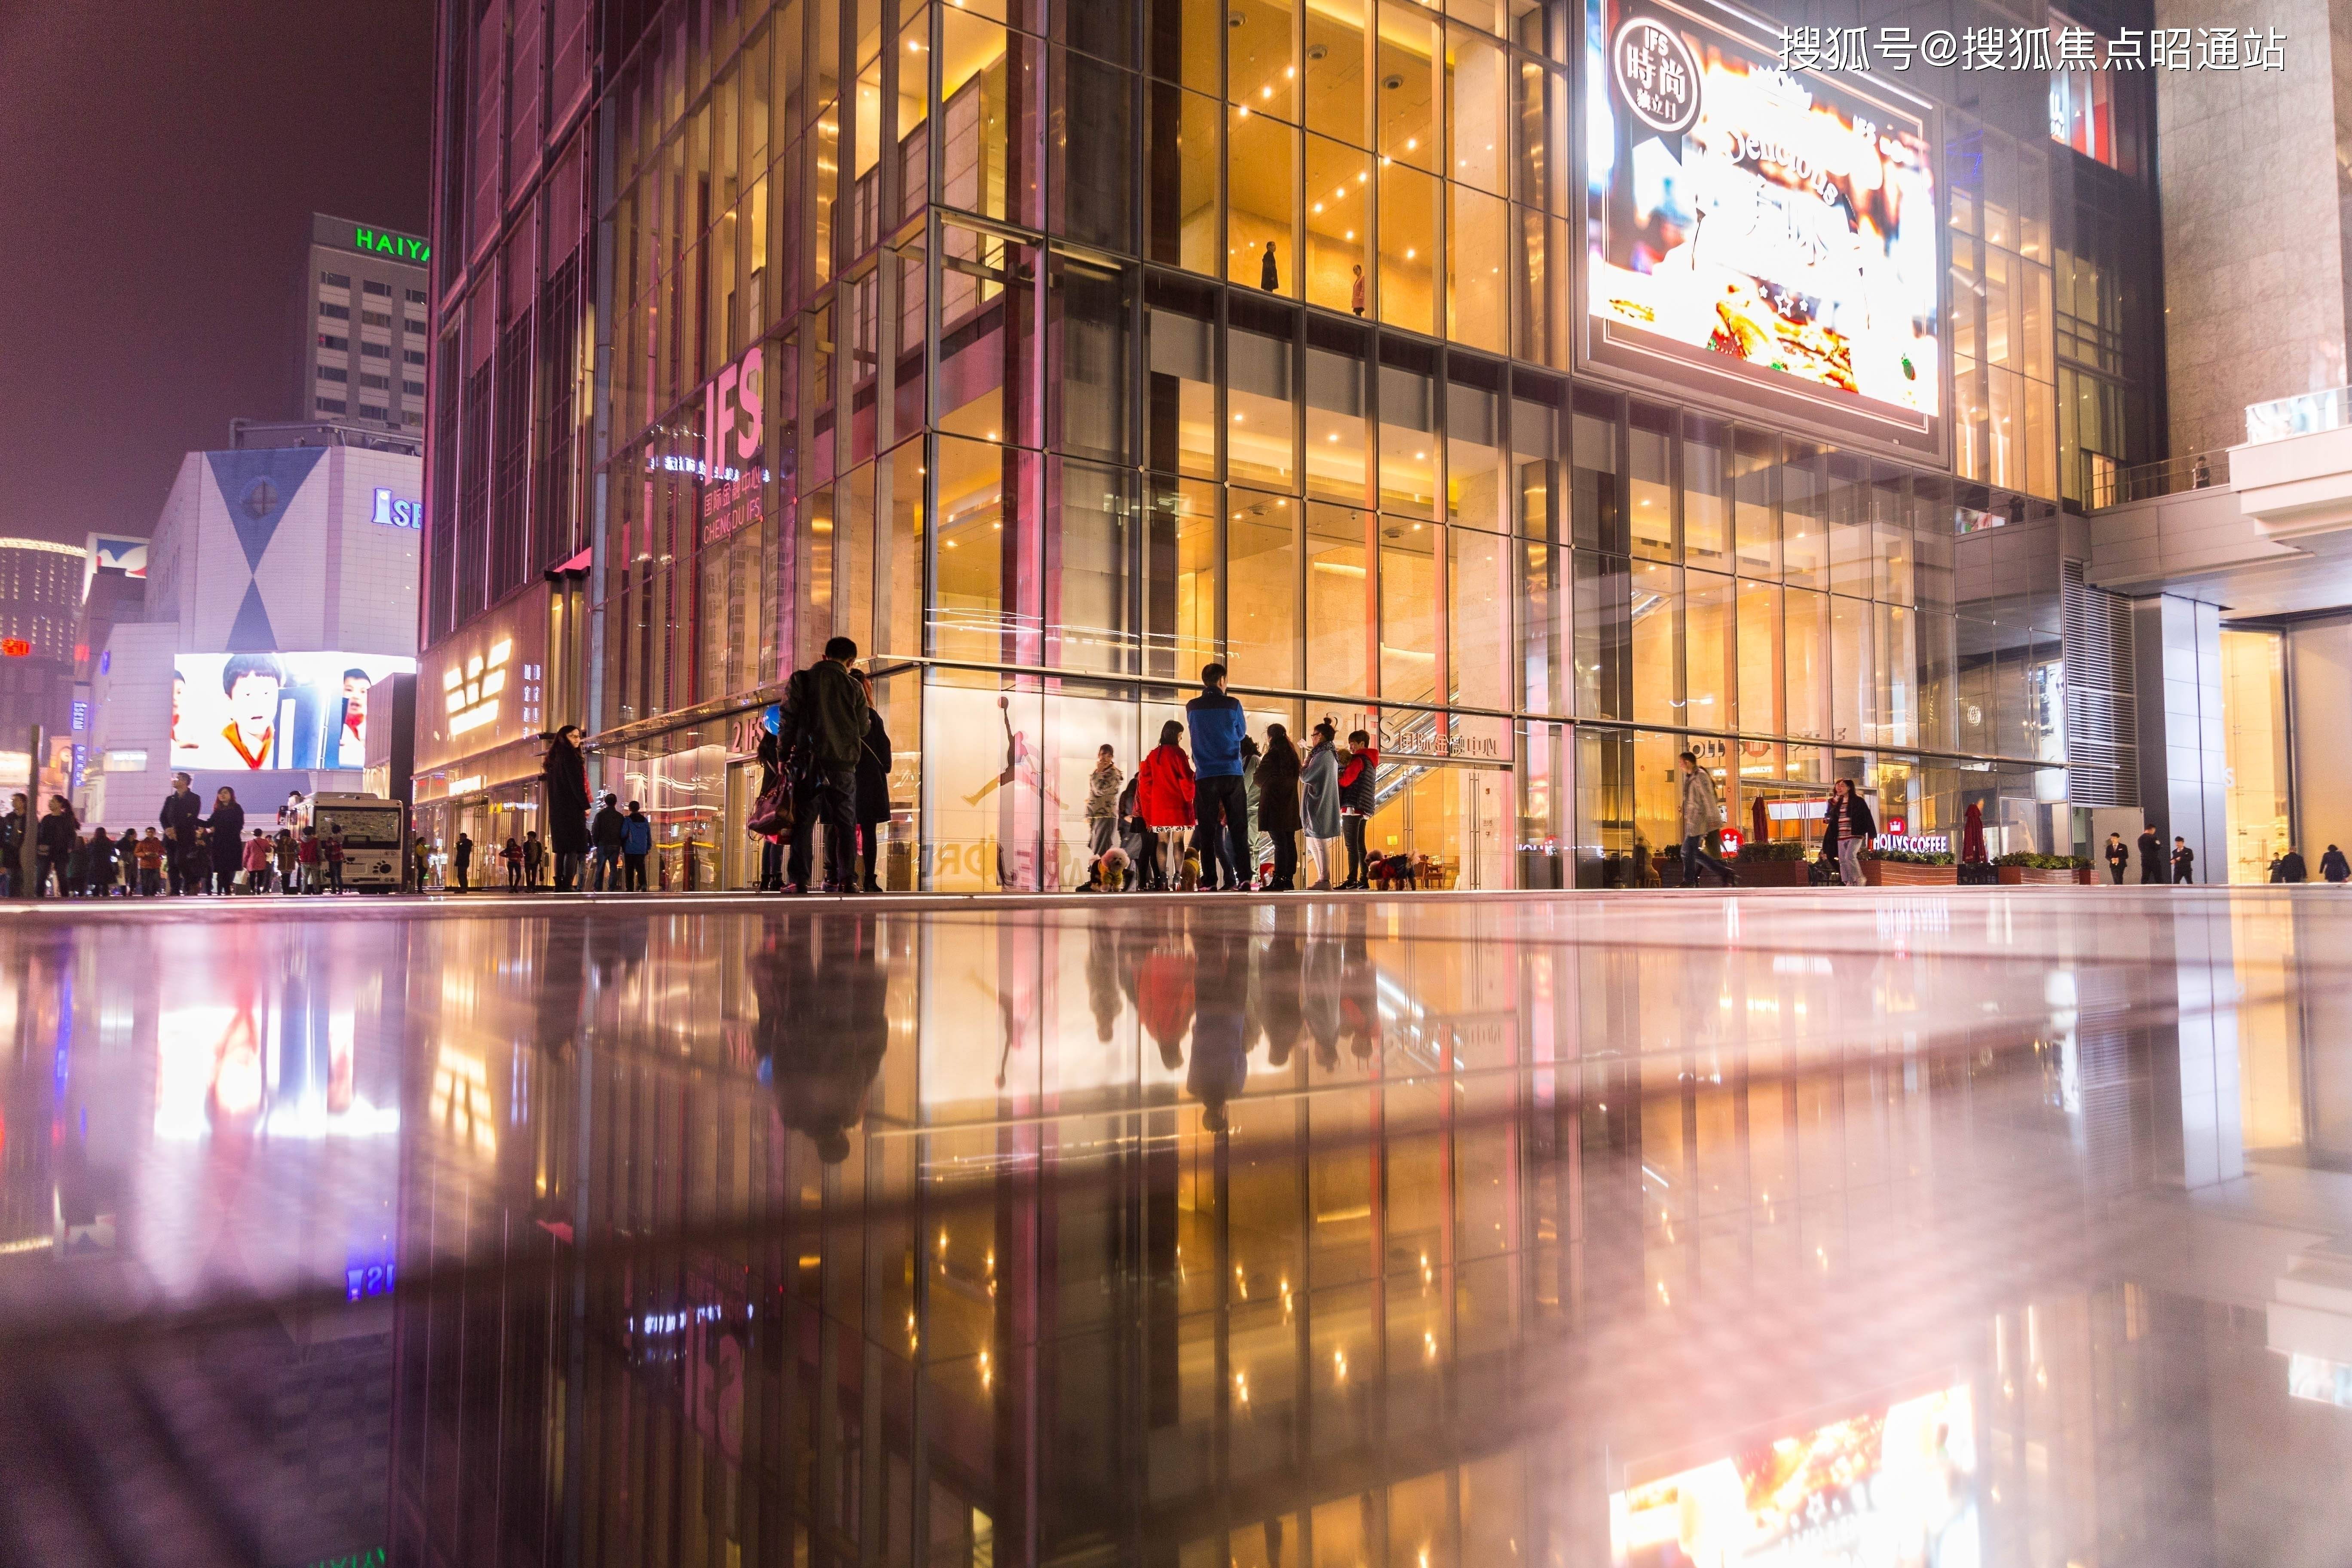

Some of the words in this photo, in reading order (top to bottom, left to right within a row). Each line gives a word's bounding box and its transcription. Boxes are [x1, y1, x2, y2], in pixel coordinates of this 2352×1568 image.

[1645, 26, 1669, 56] IFS
[1627, 43, 1685, 104] 時尚
[704, 347, 762, 487] IFS
[704, 465, 760, 518] 国际金融中心
[703, 505, 744, 544] CHENGDU
[747, 496, 760, 522] IFS
[732, 721, 742, 753] 2
[1399, 730, 1498, 756] 国际金融中心
[1873, 833, 1909, 852] HOLLYS
[1909, 836, 1947, 853] COFFEE
